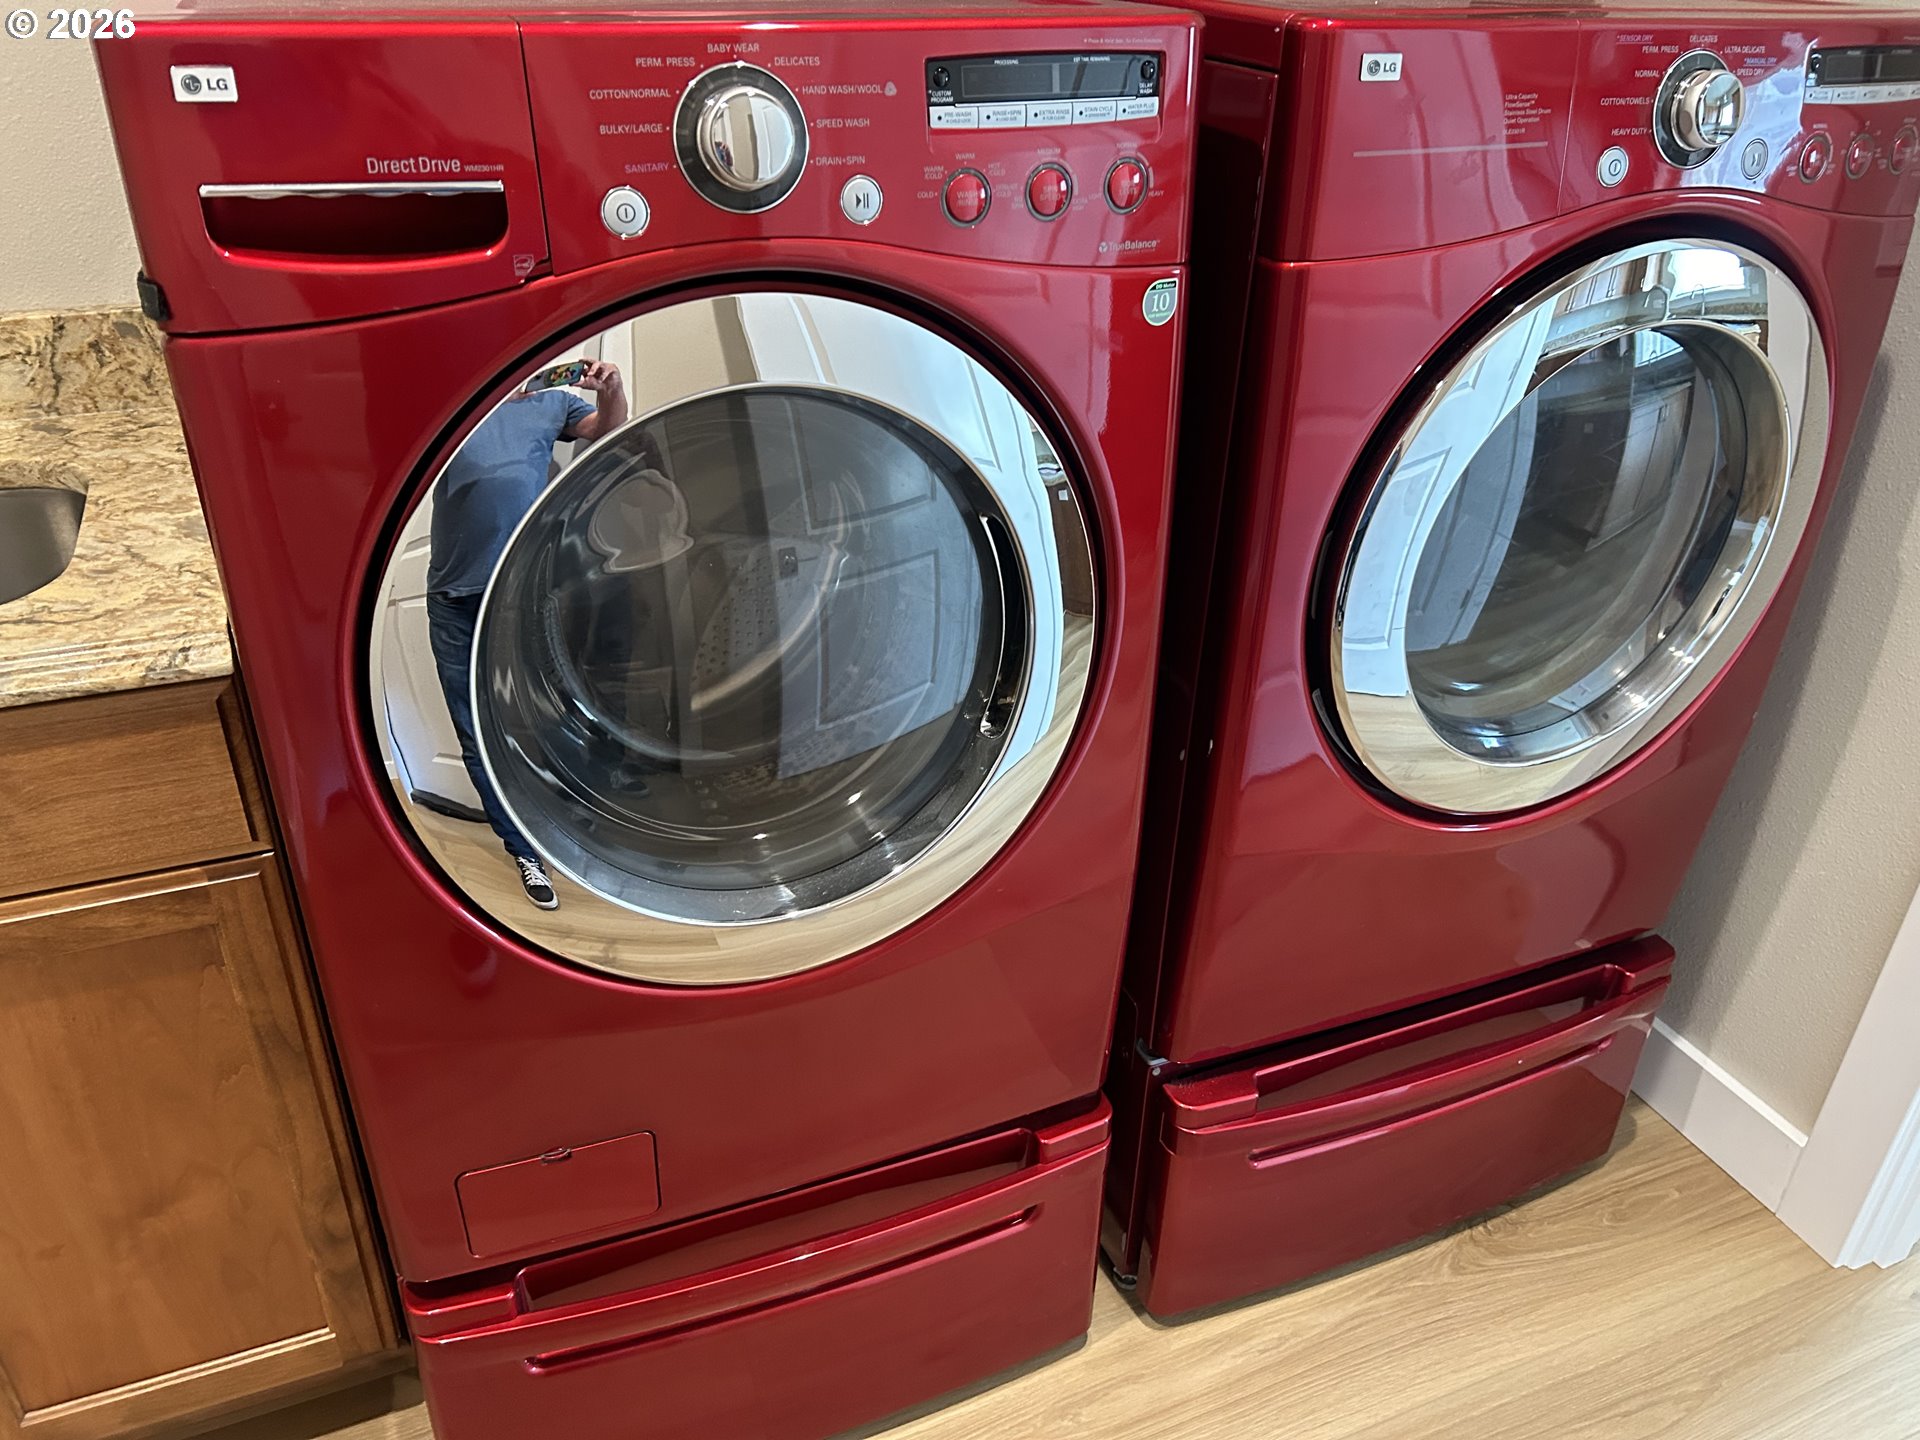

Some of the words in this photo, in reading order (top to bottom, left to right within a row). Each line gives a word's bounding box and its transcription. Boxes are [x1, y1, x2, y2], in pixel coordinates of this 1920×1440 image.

[1689, 35, 1718, 43] DELICATES
[707, 43, 731, 53] BABY
[732, 43, 760, 53] WEAR
[1660, 45, 1679, 53] PRESS
[636, 57, 664, 67] PERM.
[666, 57, 695, 67] PRESS
[774, 56, 820, 66] DELICATES
[1383, 62, 1397, 73] LG
[1736, 68, 1751, 76] SPEED
[1634, 70, 1660, 78] NORMAL
[206, 78, 229, 91] LG
[802, 85, 824, 95] HAND
[825, 84, 883, 94] WASH/WOOL
[589, 89, 671, 100] COTTON/NORMAL
[1600, 98, 1650, 106] COTTON/TOWELS
[816, 118, 843, 128] SPEED
[845, 117, 870, 128] WASH
[600, 123, 664, 134] BULKY/LARGE
[1611, 128, 1630, 136] HEAVY
[1631, 128, 1648, 136] DUTY
[366, 157, 416, 174] Direct
[418, 156, 461, 173] Drive
[815, 155, 865, 166] DRAIN+SPIN
[624, 162, 669, 174] SANITARY
[917, 191, 934, 199] COLD
[1151, 292, 1170, 312] 10
